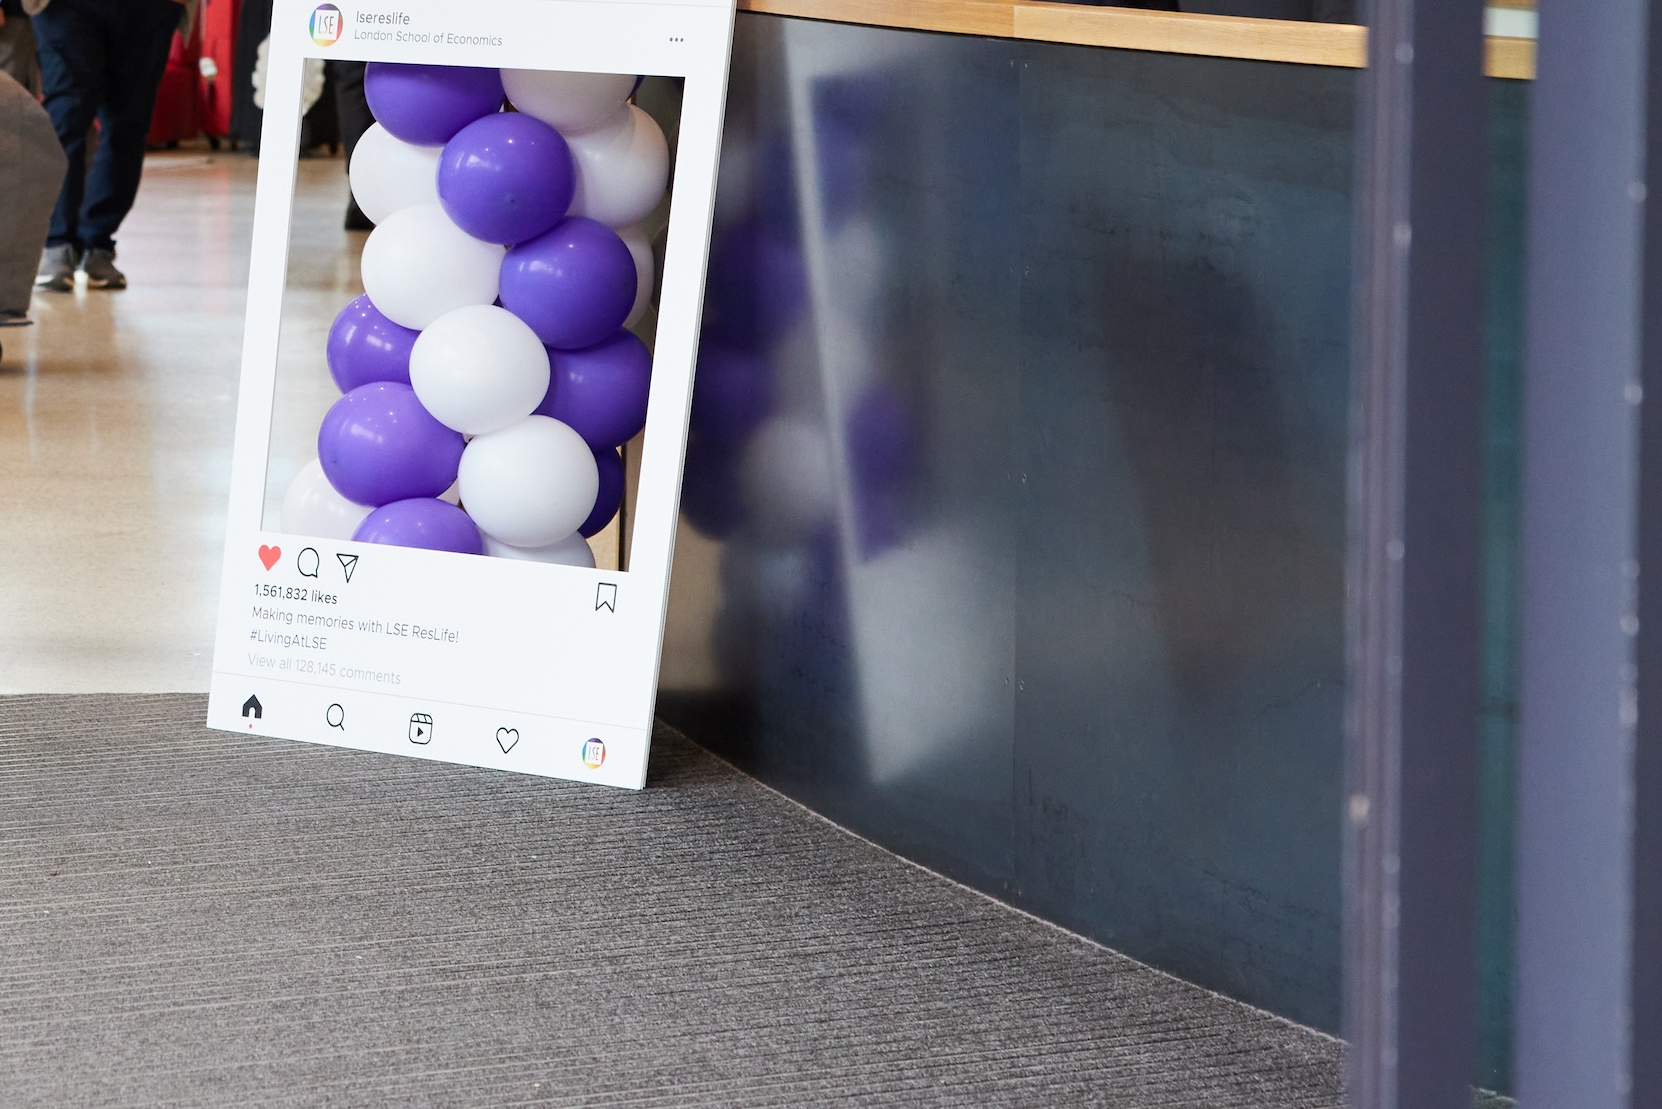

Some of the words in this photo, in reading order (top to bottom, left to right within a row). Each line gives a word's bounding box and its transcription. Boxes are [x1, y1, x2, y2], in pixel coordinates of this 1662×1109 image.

[318, 14, 335, 35] LSE
[354, 29, 393, 42] London
[395, 30, 431, 44] School
[433, 32, 445, 44] of
[446, 33, 503, 47] Economics
[254, 583, 308, 601] 1,561,832
[311, 589, 338, 605] likes
[252, 606, 293, 625] Making
[296, 612, 354, 631] memories
[358, 619, 383, 634] with
[386, 622, 409, 637] LSE
[412, 625, 459, 644] ResLife!
[250, 628, 328, 651] #LivingAtLSE
[248, 653, 276, 669] View
[279, 657, 293, 671] all
[296, 659, 337, 677] 128,145
[339, 667, 402, 685] comments
